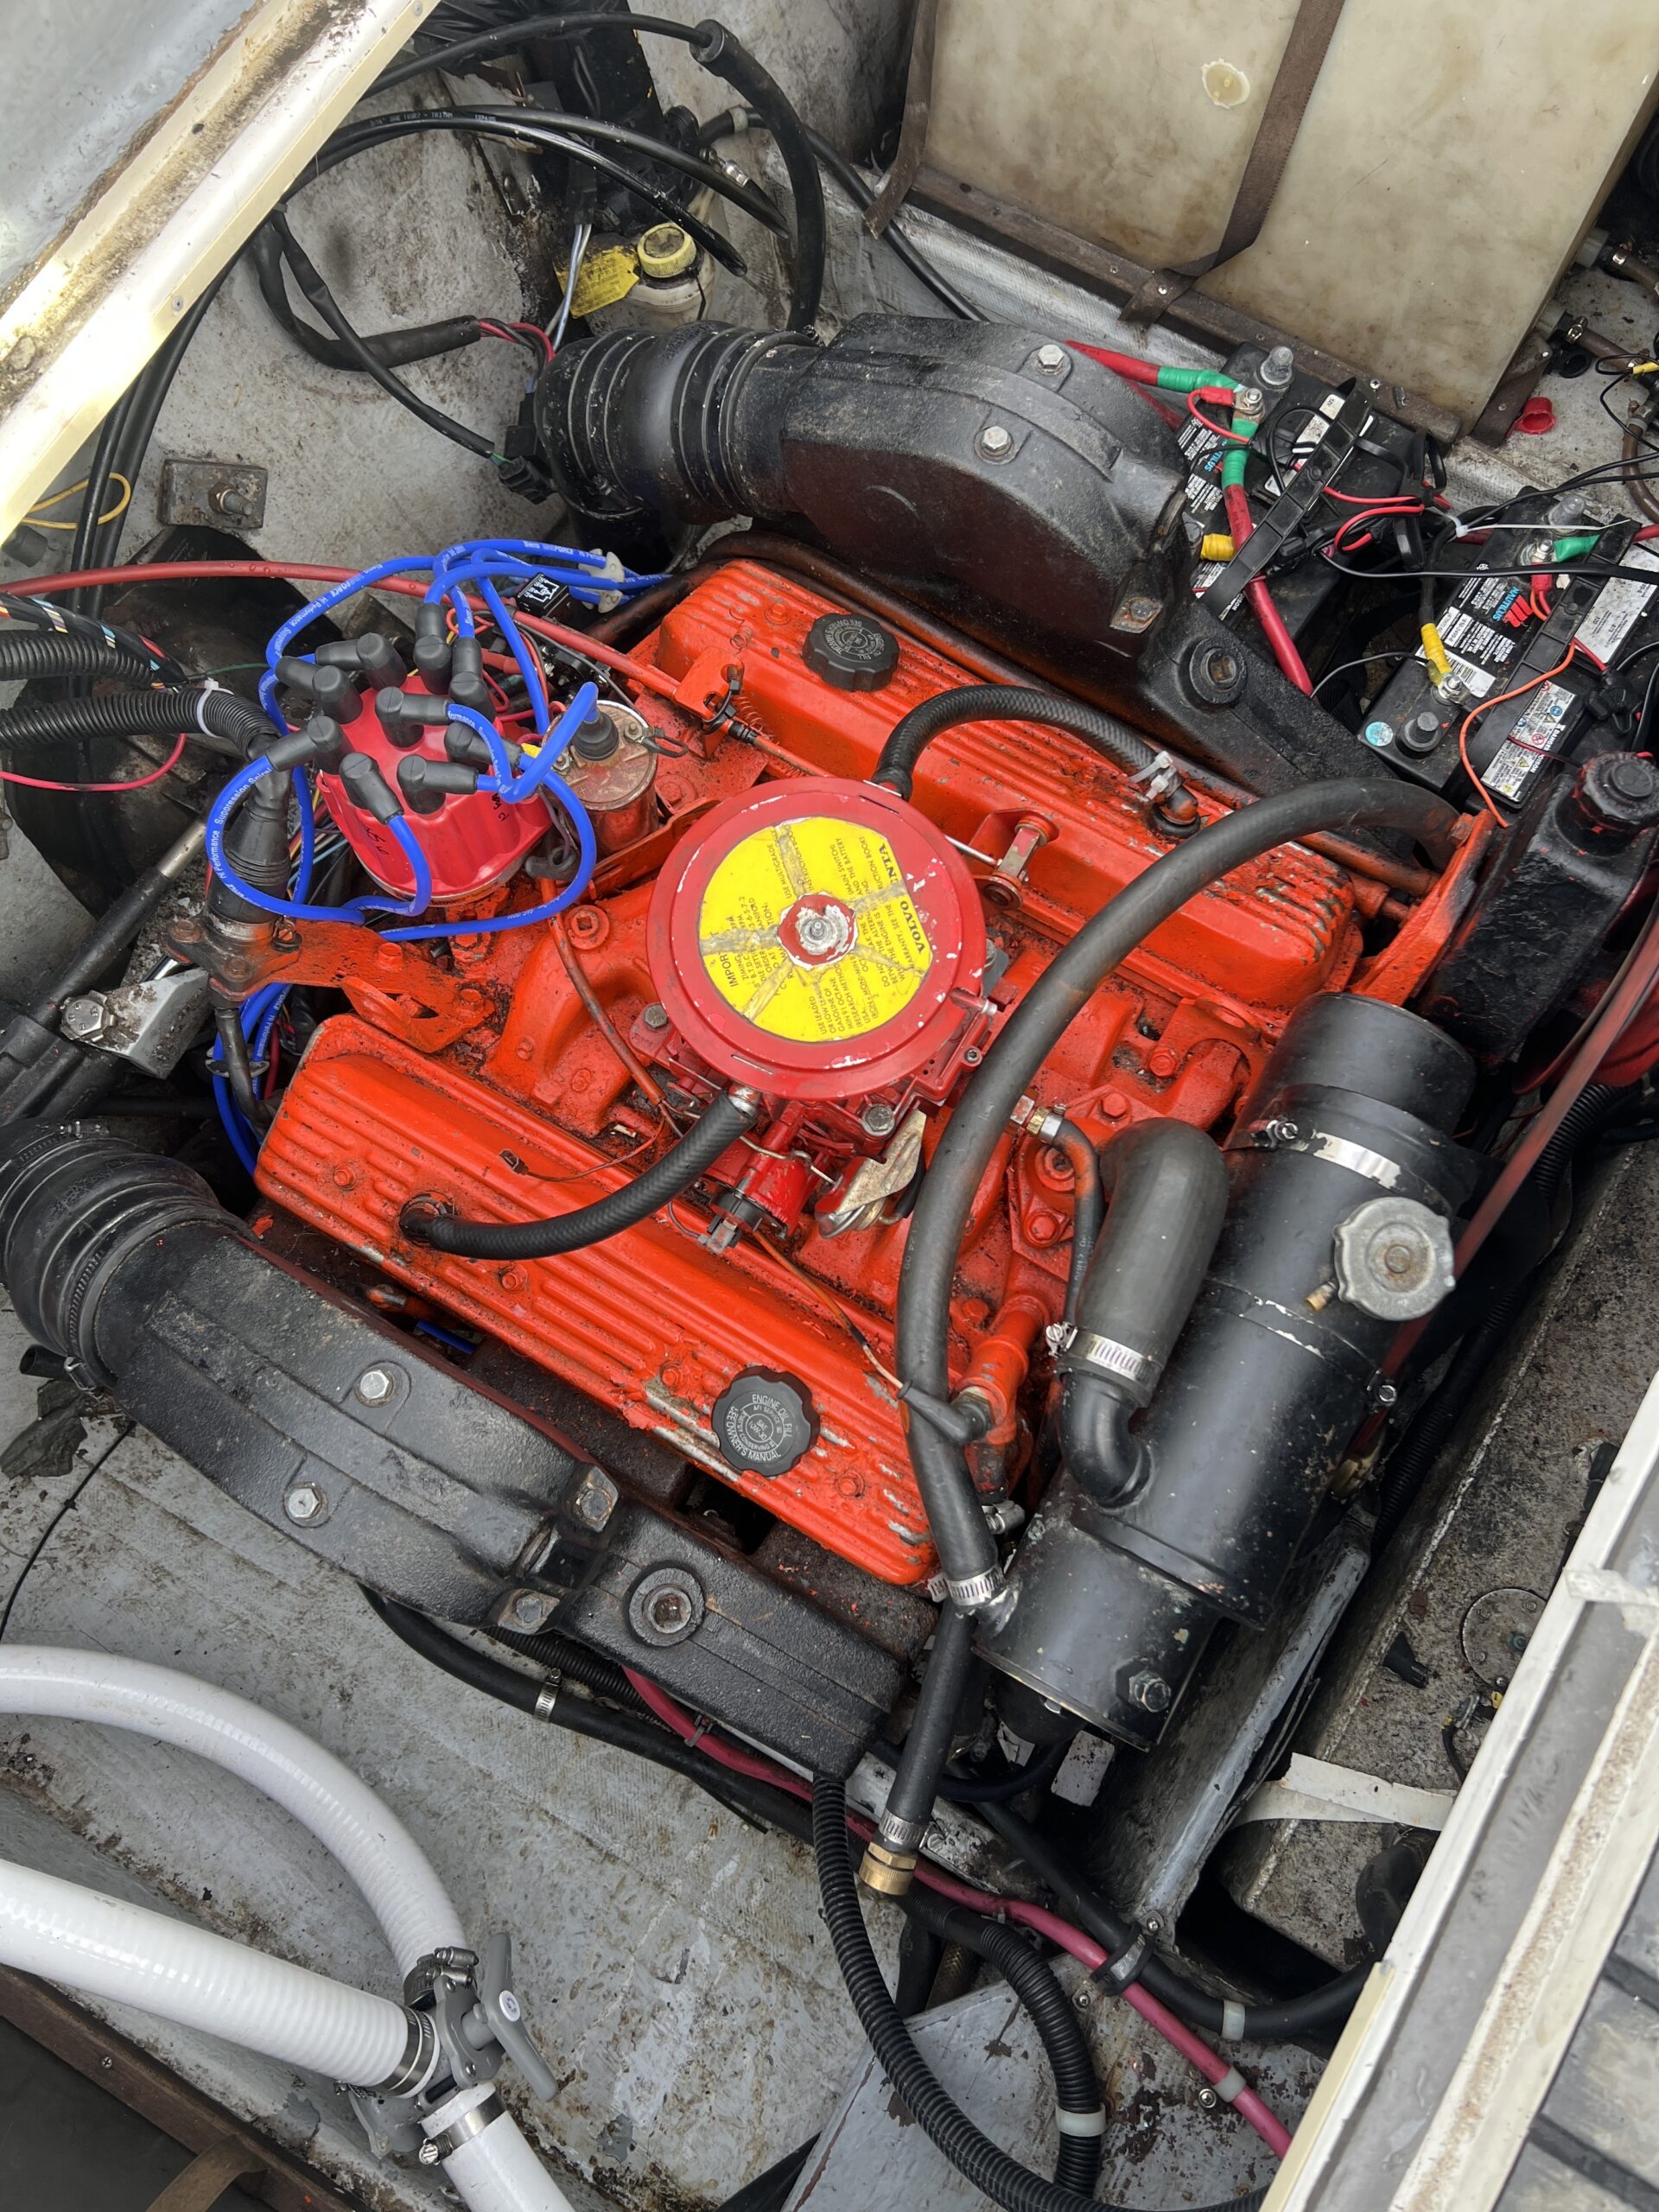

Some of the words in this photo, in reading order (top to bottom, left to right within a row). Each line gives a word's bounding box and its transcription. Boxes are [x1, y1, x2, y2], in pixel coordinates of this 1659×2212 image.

[1493, 587, 1520, 621] NAUTILUS
[214, 785, 248, 825] Suppression
[212, 830, 221, 872] Performance
[830, 843, 843, 872] SWITCH)
[836, 837, 849, 864] BATTERY
[767, 843, 785, 885] MULTIGRADE
[846, 866, 855, 878] THE
[783, 886, 791, 899] USE
[842, 874, 853, 894] (MAIN
[852, 880, 862, 896] AND
[885, 903, 894, 916] THE
[860, 921, 868, 934] THE
[878, 919, 890, 945] ENGINE
[899, 899, 925, 954] VOLVO
[875, 939, 884, 952] THE
[887, 947, 896, 959] THE
[734, 954, 747, 980] TIMING
[760, 950, 772, 972] ORDER
[875, 962, 885, 974] NO
[880, 975, 889, 987] DO
[823, 987, 831, 996] OF
[830, 976, 843, 1006] OCTANE
[809, 995, 821, 1020] LEADED
[821, 1006, 831, 1022] LOW
[828, 996, 844, 1032] GASOLINE
[845, 992, 861, 1027] (RESEARCH
[818, 1021, 827, 1033] USE
[828, 1023, 836, 1033] OR
[843, 1014, 854, 1029] MIN
[752, 1394, 780, 1412] ENGINE
[778, 1408, 789, 1423] OIL
[784, 1423, 792, 1438] FILL
[764, 1407, 781, 1425] SERVICE
[757, 1420, 768, 1431] SAE
[748, 1451, 781, 1462] MANUAL
